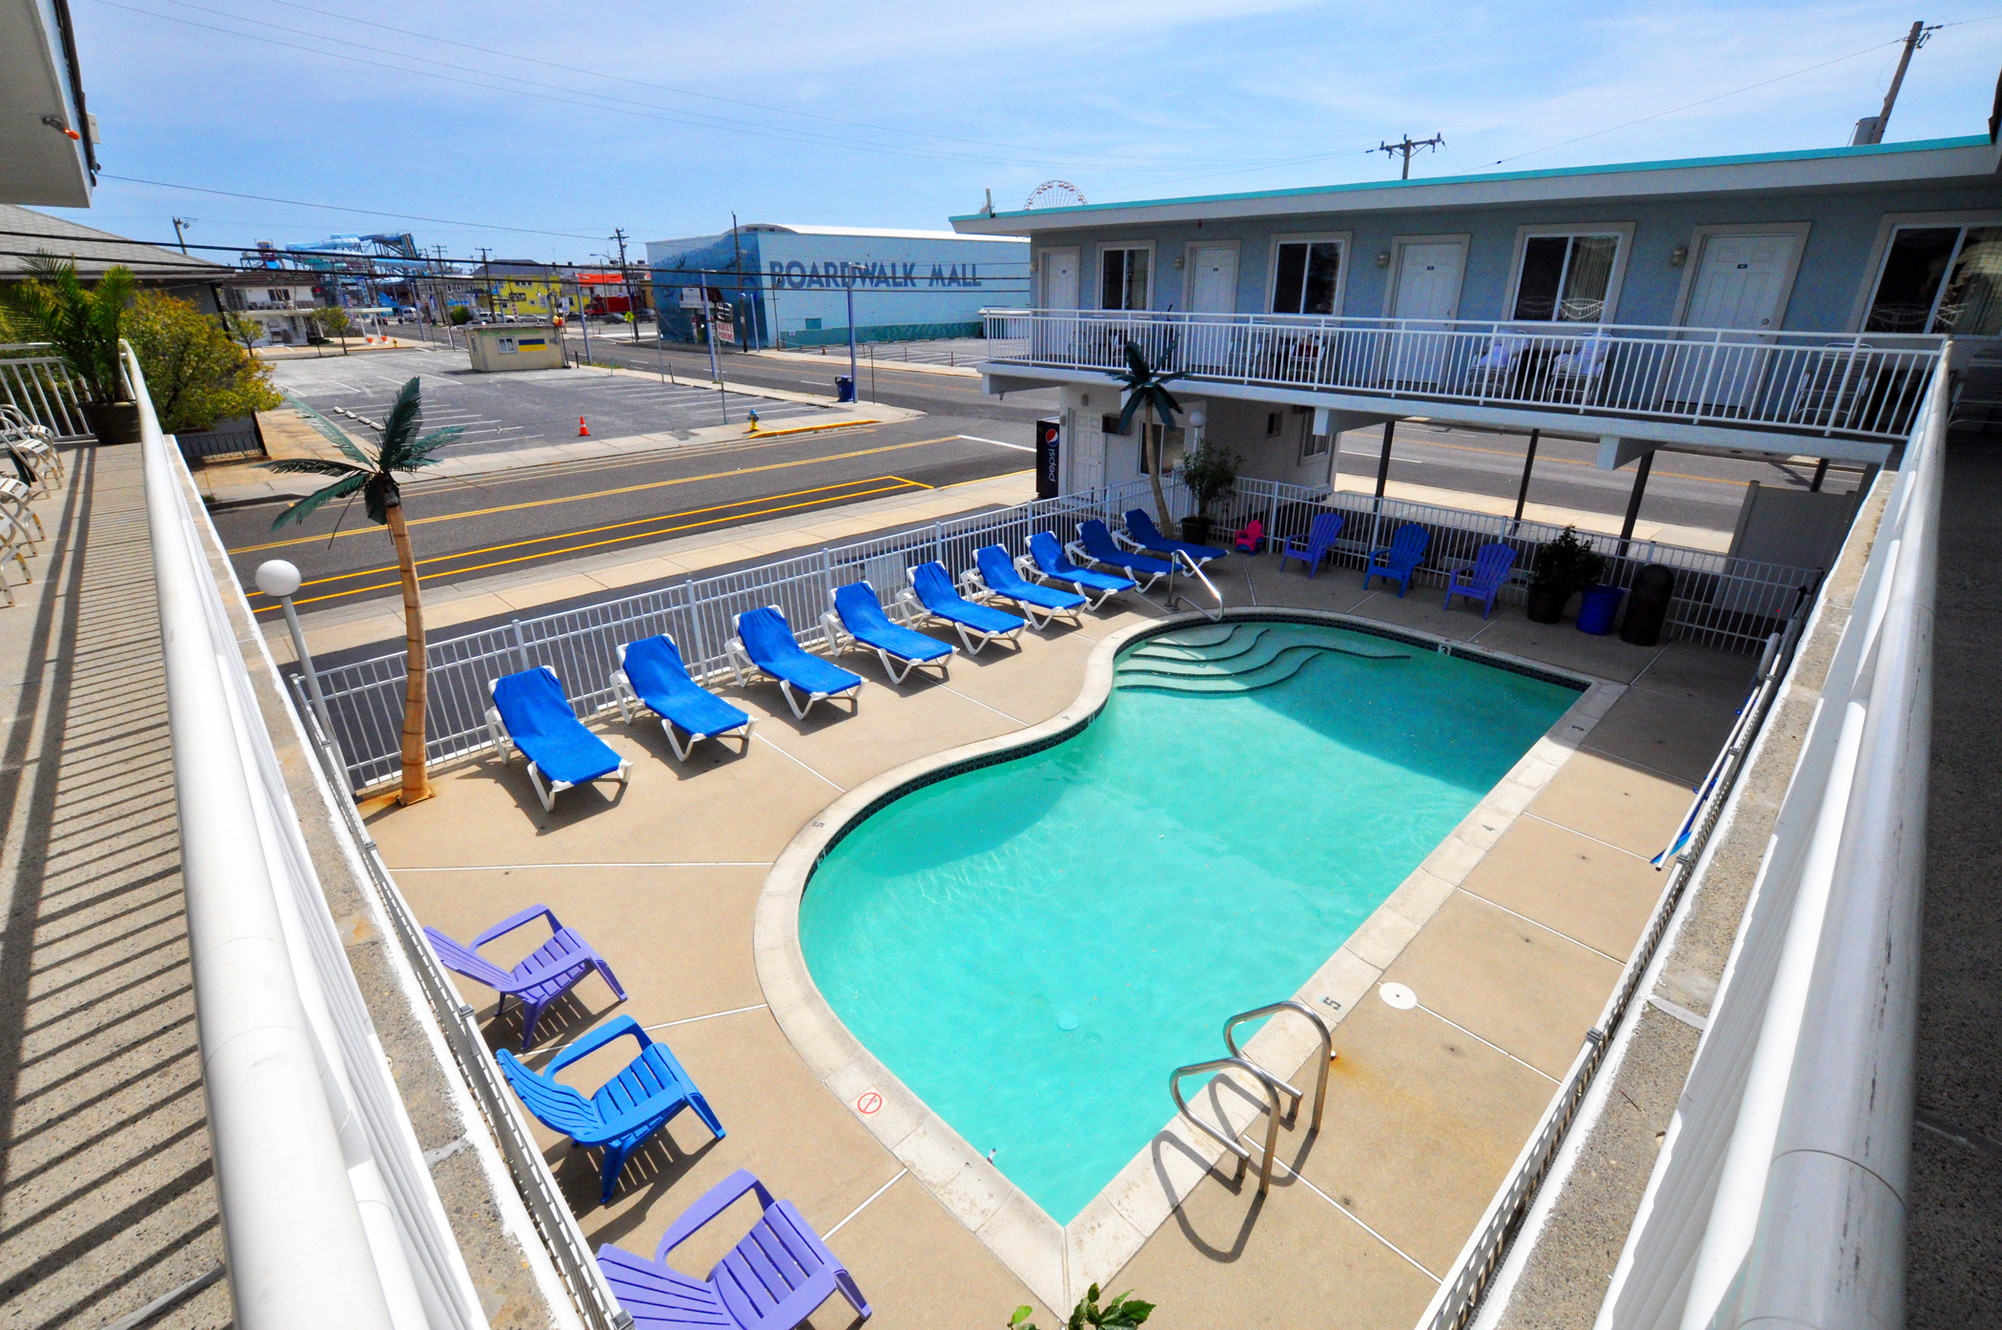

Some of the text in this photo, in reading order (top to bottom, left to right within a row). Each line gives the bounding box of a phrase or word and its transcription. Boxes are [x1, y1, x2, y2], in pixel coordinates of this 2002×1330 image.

[768, 260, 983, 288] BOARDWALK MALL
[1048, 448, 1057, 482] pepsi
[1440, 645, 1449, 655] 3
[1322, 996, 1342, 1010] 5
